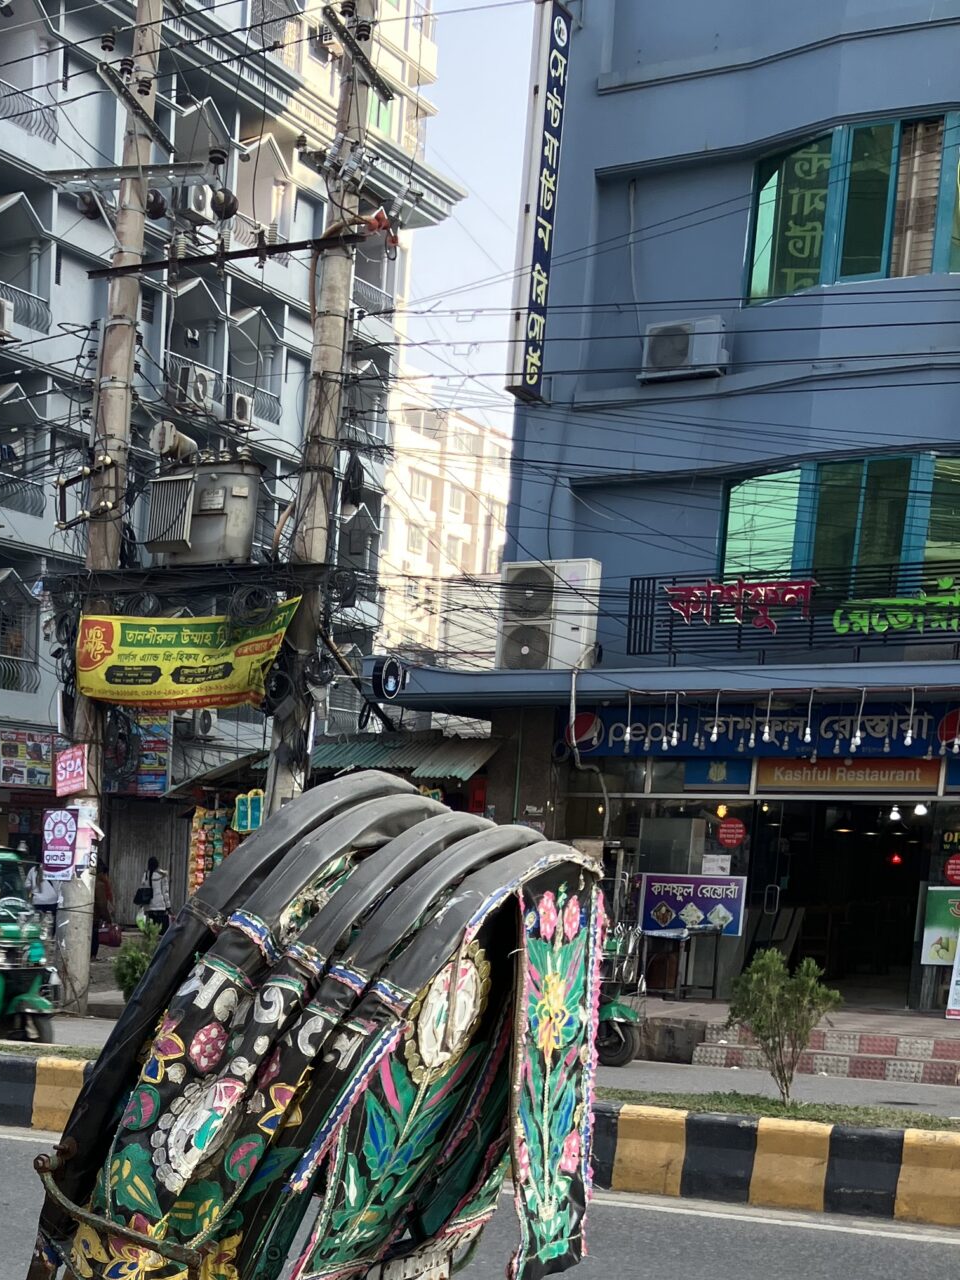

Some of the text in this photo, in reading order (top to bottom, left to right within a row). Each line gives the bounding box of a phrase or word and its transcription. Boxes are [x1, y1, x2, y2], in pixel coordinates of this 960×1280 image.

[663, 576, 820, 635] কাশফুল
[608, 717, 688, 748] pepsi
[700, 715, 808, 746] কাশফুল
[57, 758, 83, 781] SPA
[773, 766, 920, 782] Kashful Restaurant
[651, 882, 694, 902] কাশফুল
